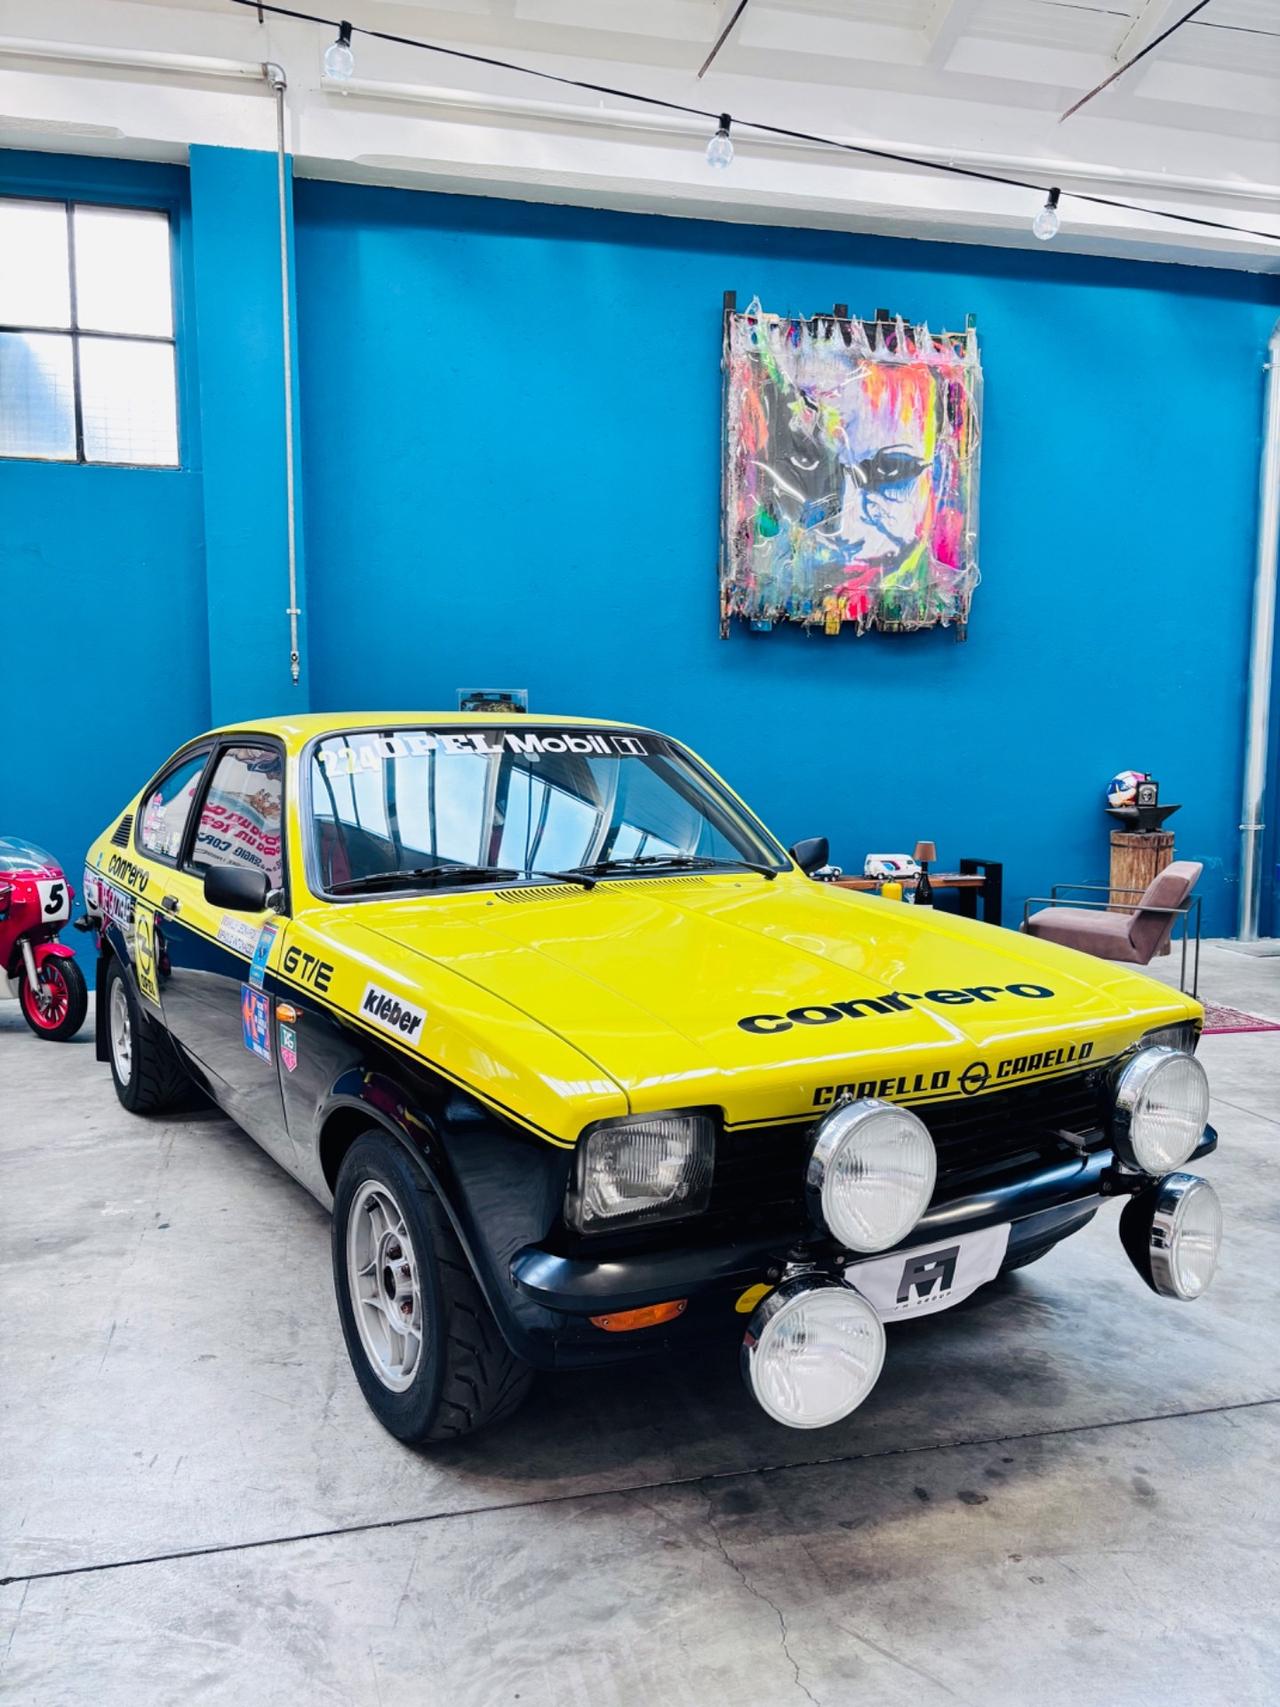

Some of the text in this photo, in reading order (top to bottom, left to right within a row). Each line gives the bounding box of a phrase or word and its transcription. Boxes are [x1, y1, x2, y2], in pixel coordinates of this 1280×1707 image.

[374, 731, 505, 758] OPEL
[504, 734, 613, 754] Mobil
[108, 853, 150, 893] conrero
[43, 883, 65, 915] 5
[283, 945, 334, 993] GT/E
[737, 982, 1055, 1034] conrero
[995, 1041, 1095, 1079] CARELLO
